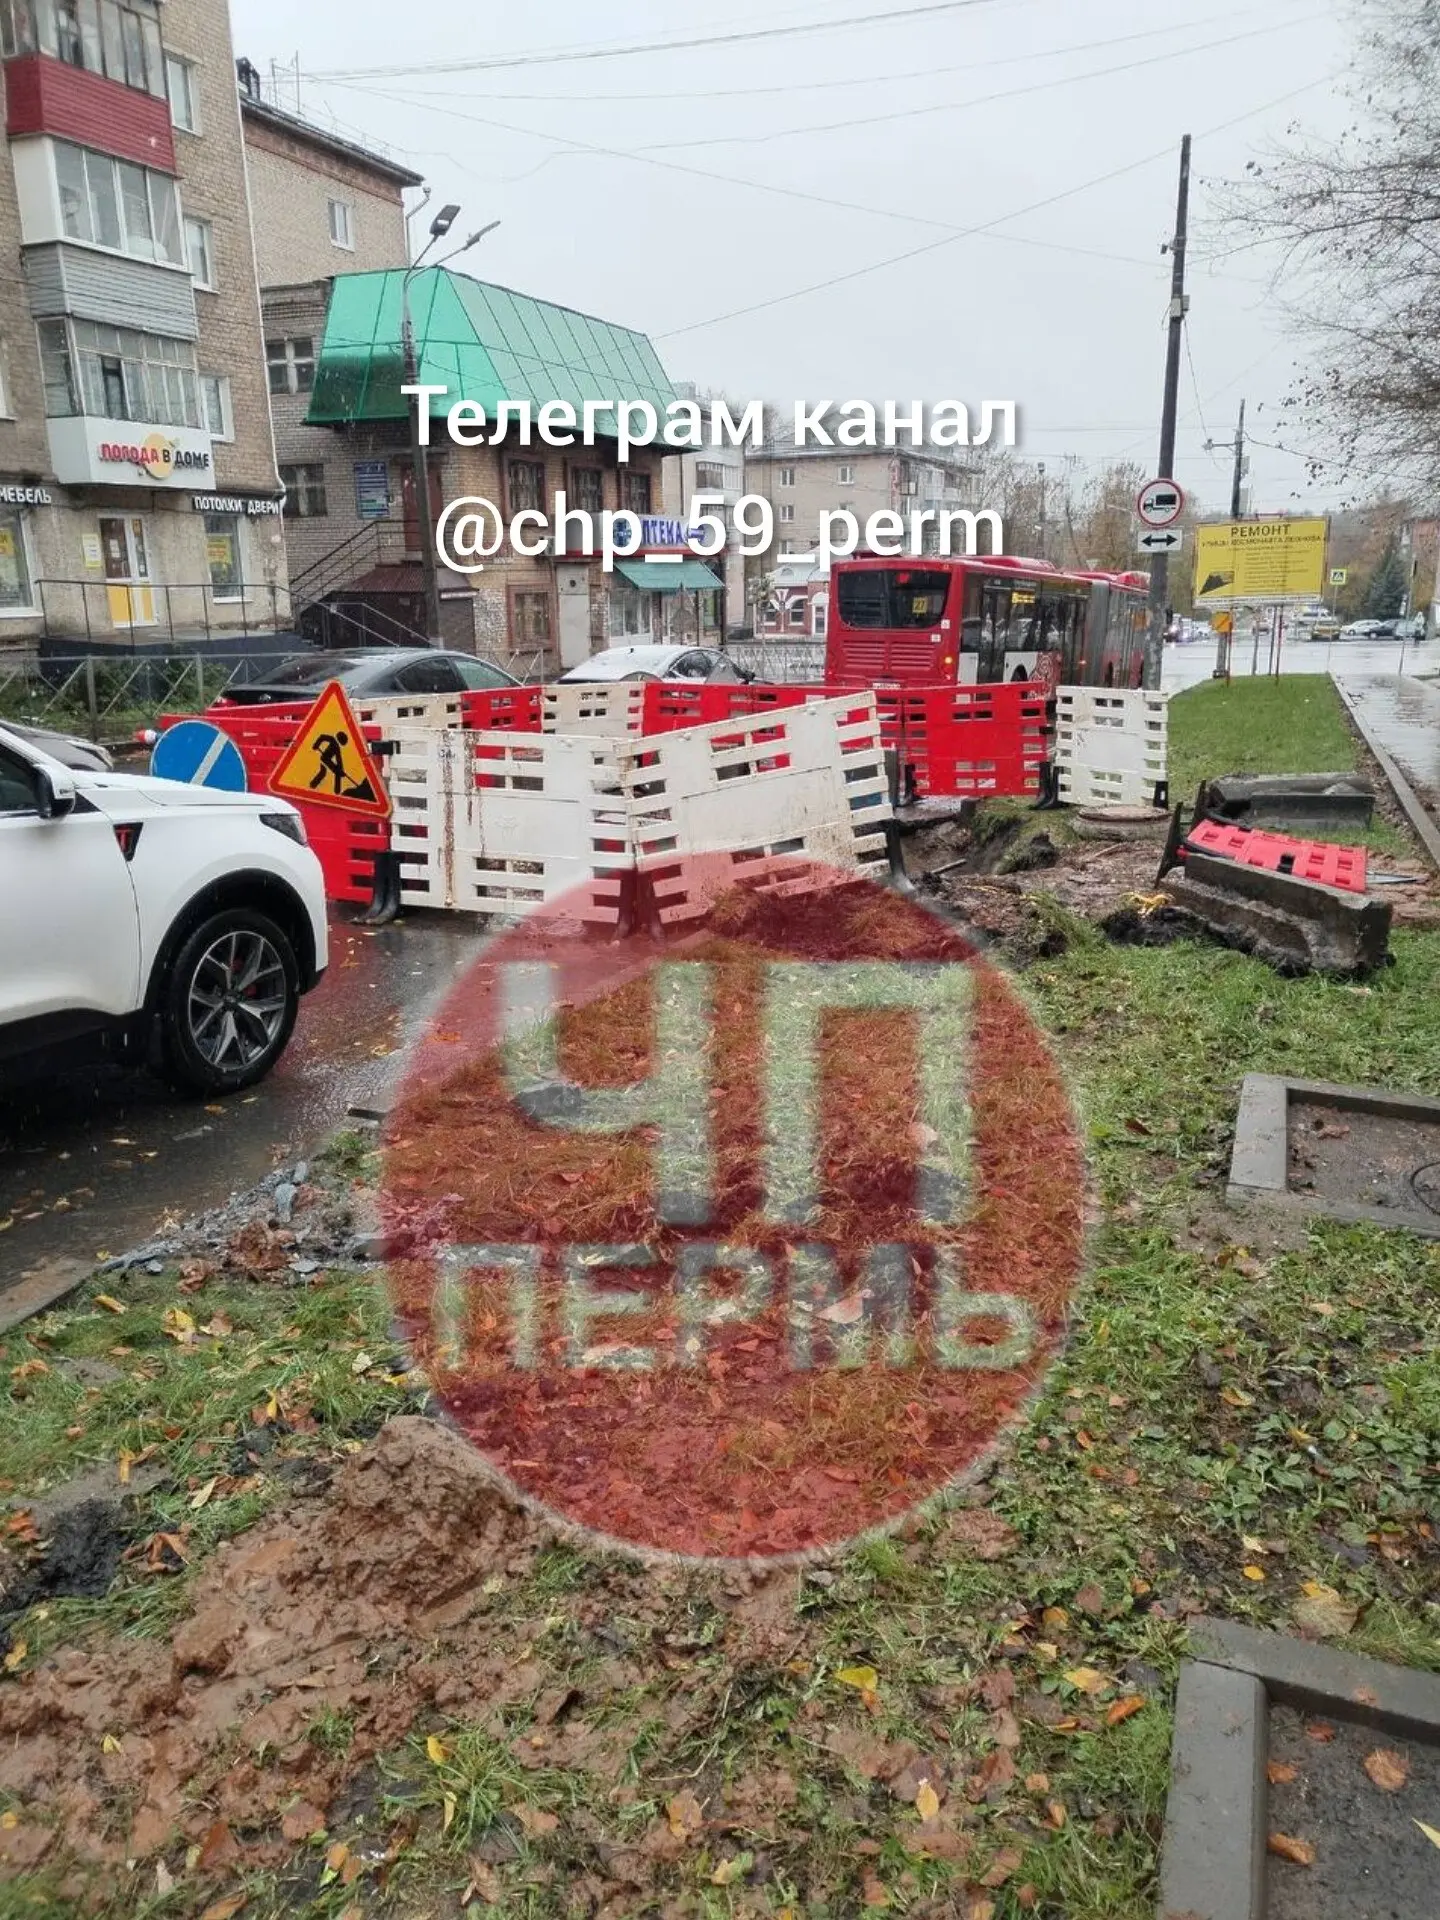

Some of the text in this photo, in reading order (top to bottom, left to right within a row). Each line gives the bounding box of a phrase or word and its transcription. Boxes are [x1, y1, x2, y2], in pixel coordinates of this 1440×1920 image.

[101, 443, 210, 469] ПОГОДА В ДОМЕ
[0, 487, 52, 504] МЕБЕЛЬ
[194, 497, 279, 515] ПОТОЛКИ ДВЕРИ
[634, 519, 686, 545] ПТЕКА
[1231, 523, 1291, 538] РЕМОНТ
